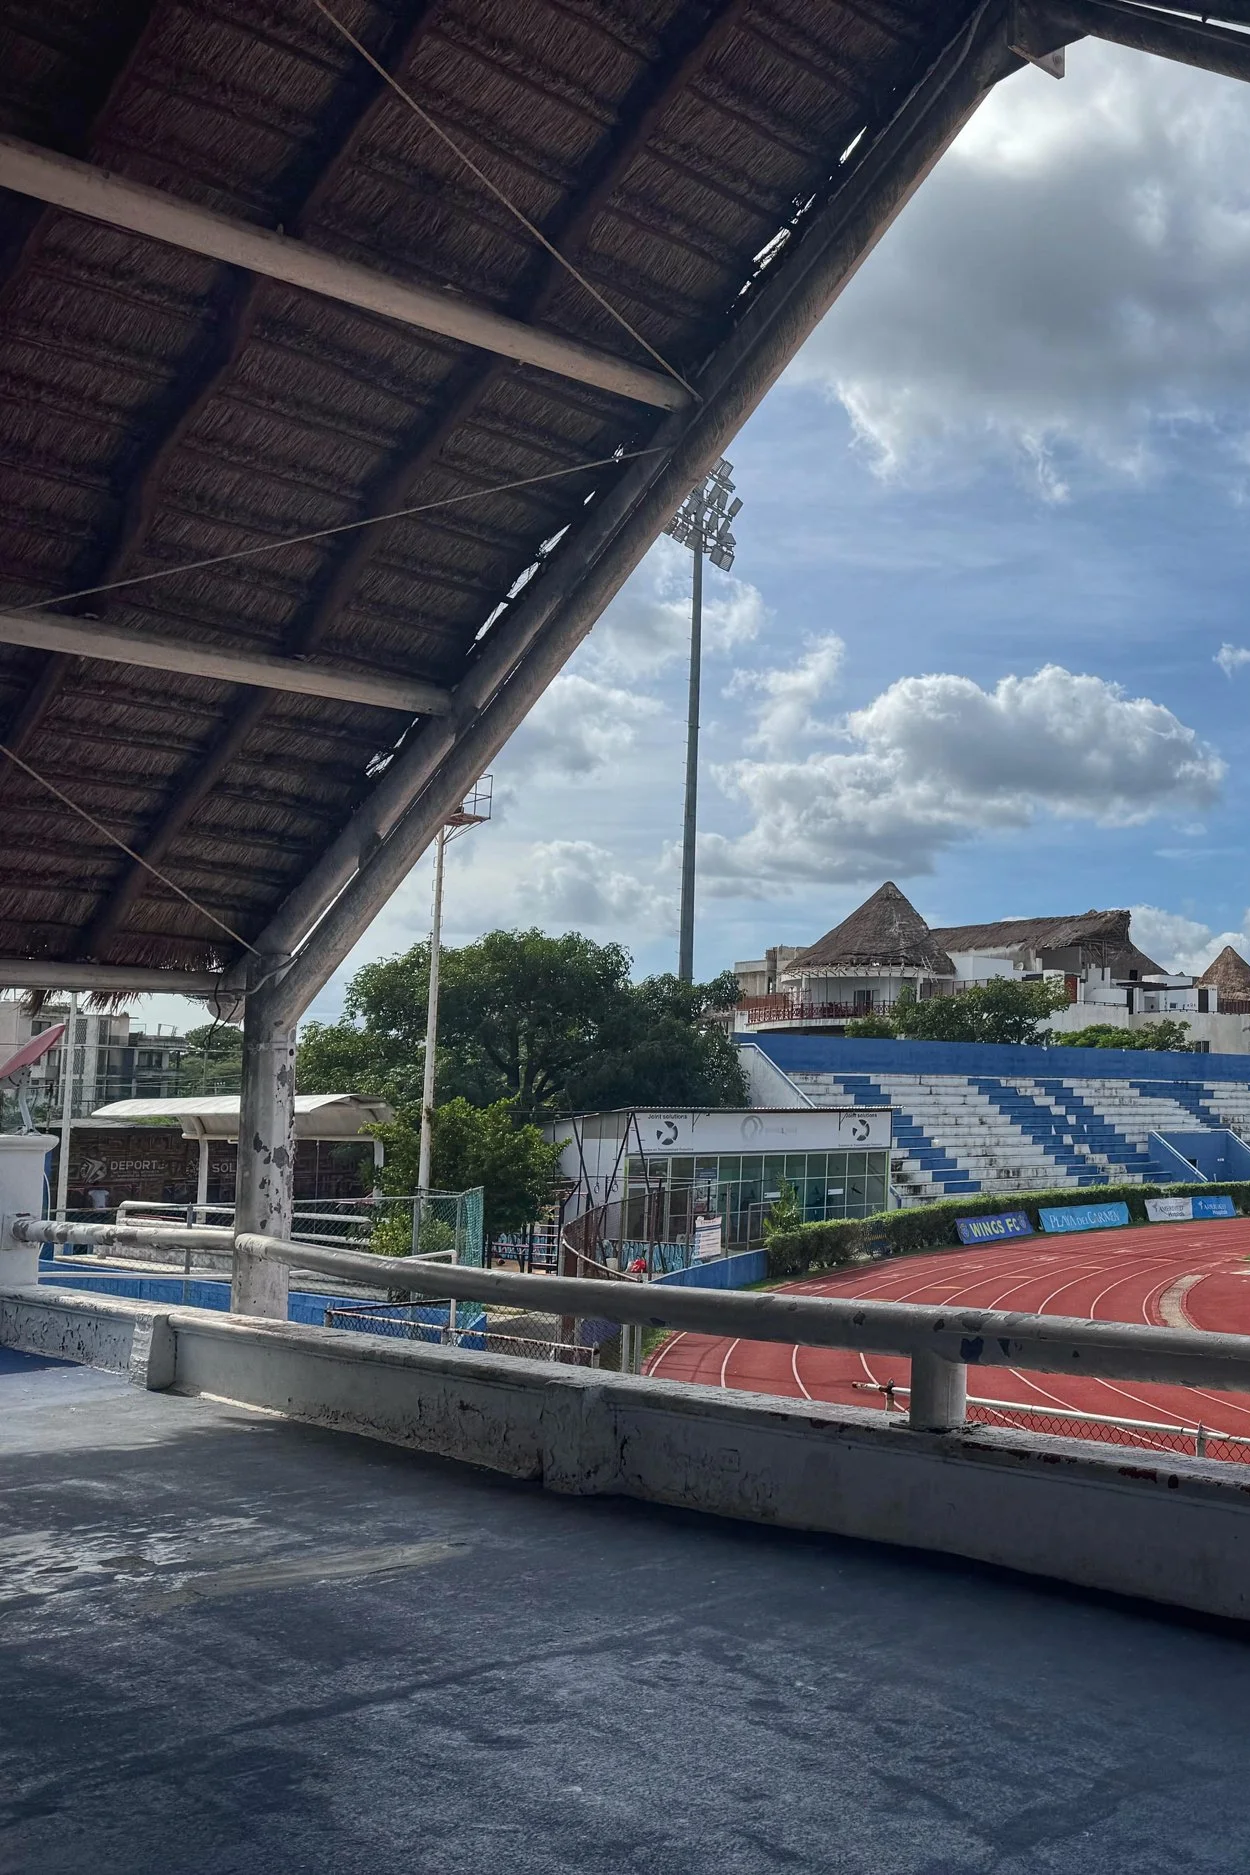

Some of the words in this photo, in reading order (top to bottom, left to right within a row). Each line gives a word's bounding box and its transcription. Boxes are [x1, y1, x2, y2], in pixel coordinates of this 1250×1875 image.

[969, 1219, 1005, 1238] WINGS
[1005, 1217, 1021, 1233] FC
[1049, 1214, 1077, 1229] PLAYA
[1087, 1210, 1120, 1224] CARMEN
